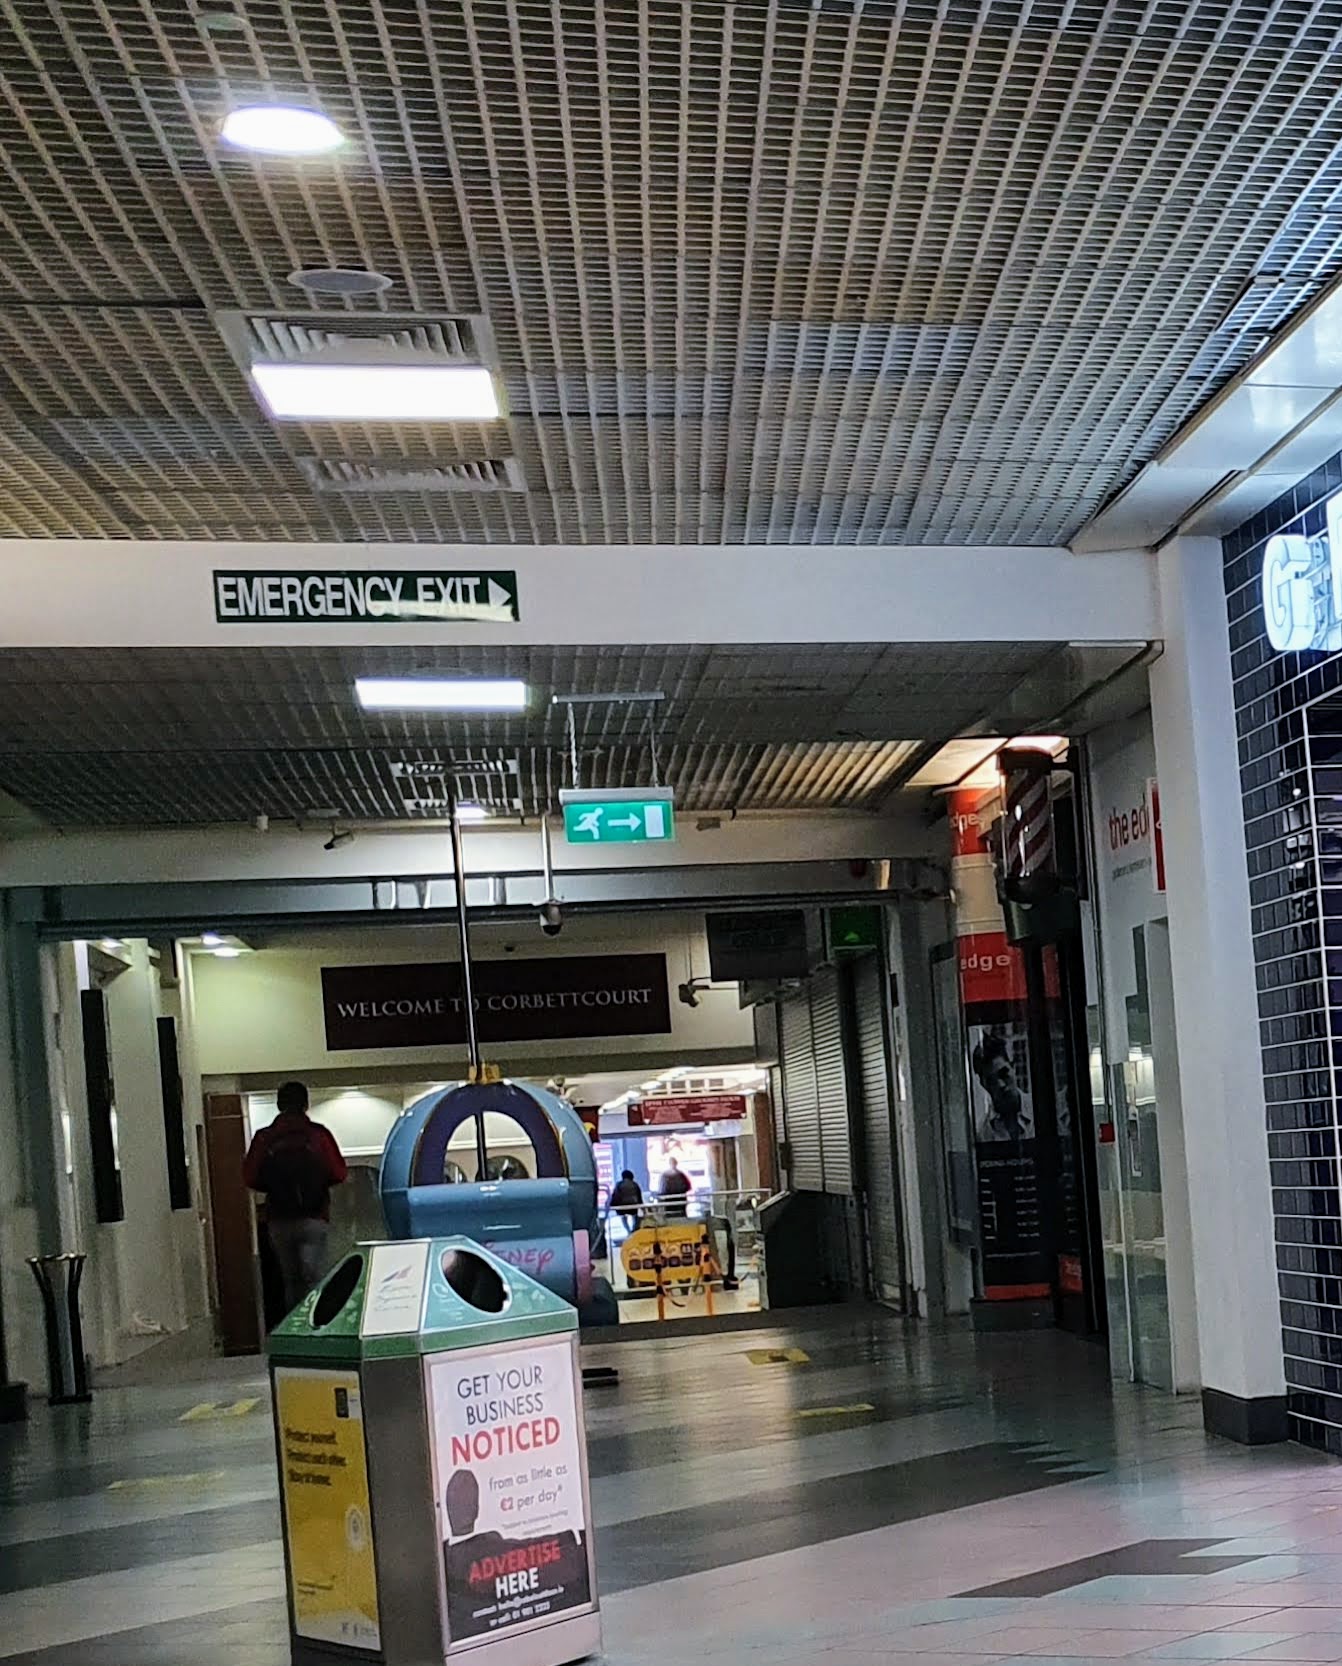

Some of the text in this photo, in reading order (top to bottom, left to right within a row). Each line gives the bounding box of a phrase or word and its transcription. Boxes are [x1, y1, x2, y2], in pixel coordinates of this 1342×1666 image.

[217, 576, 482, 617] EMERGENCY EXIT
[1109, 806, 1130, 850] the
[337, 1001, 445, 1018] WELCOME
[487, 988, 653, 1012] CORBETTCOURT
[457, 1365, 543, 1399] GET YOUR
[466, 1392, 544, 1425] BUSINESS
[451, 1416, 560, 1466] NOTICED
[489, 1464, 568, 1491] from as little as
[517, 1496, 535, 1511] per
[469, 1540, 560, 1584] ADVERTISE
[495, 1566, 540, 1599] HERE
